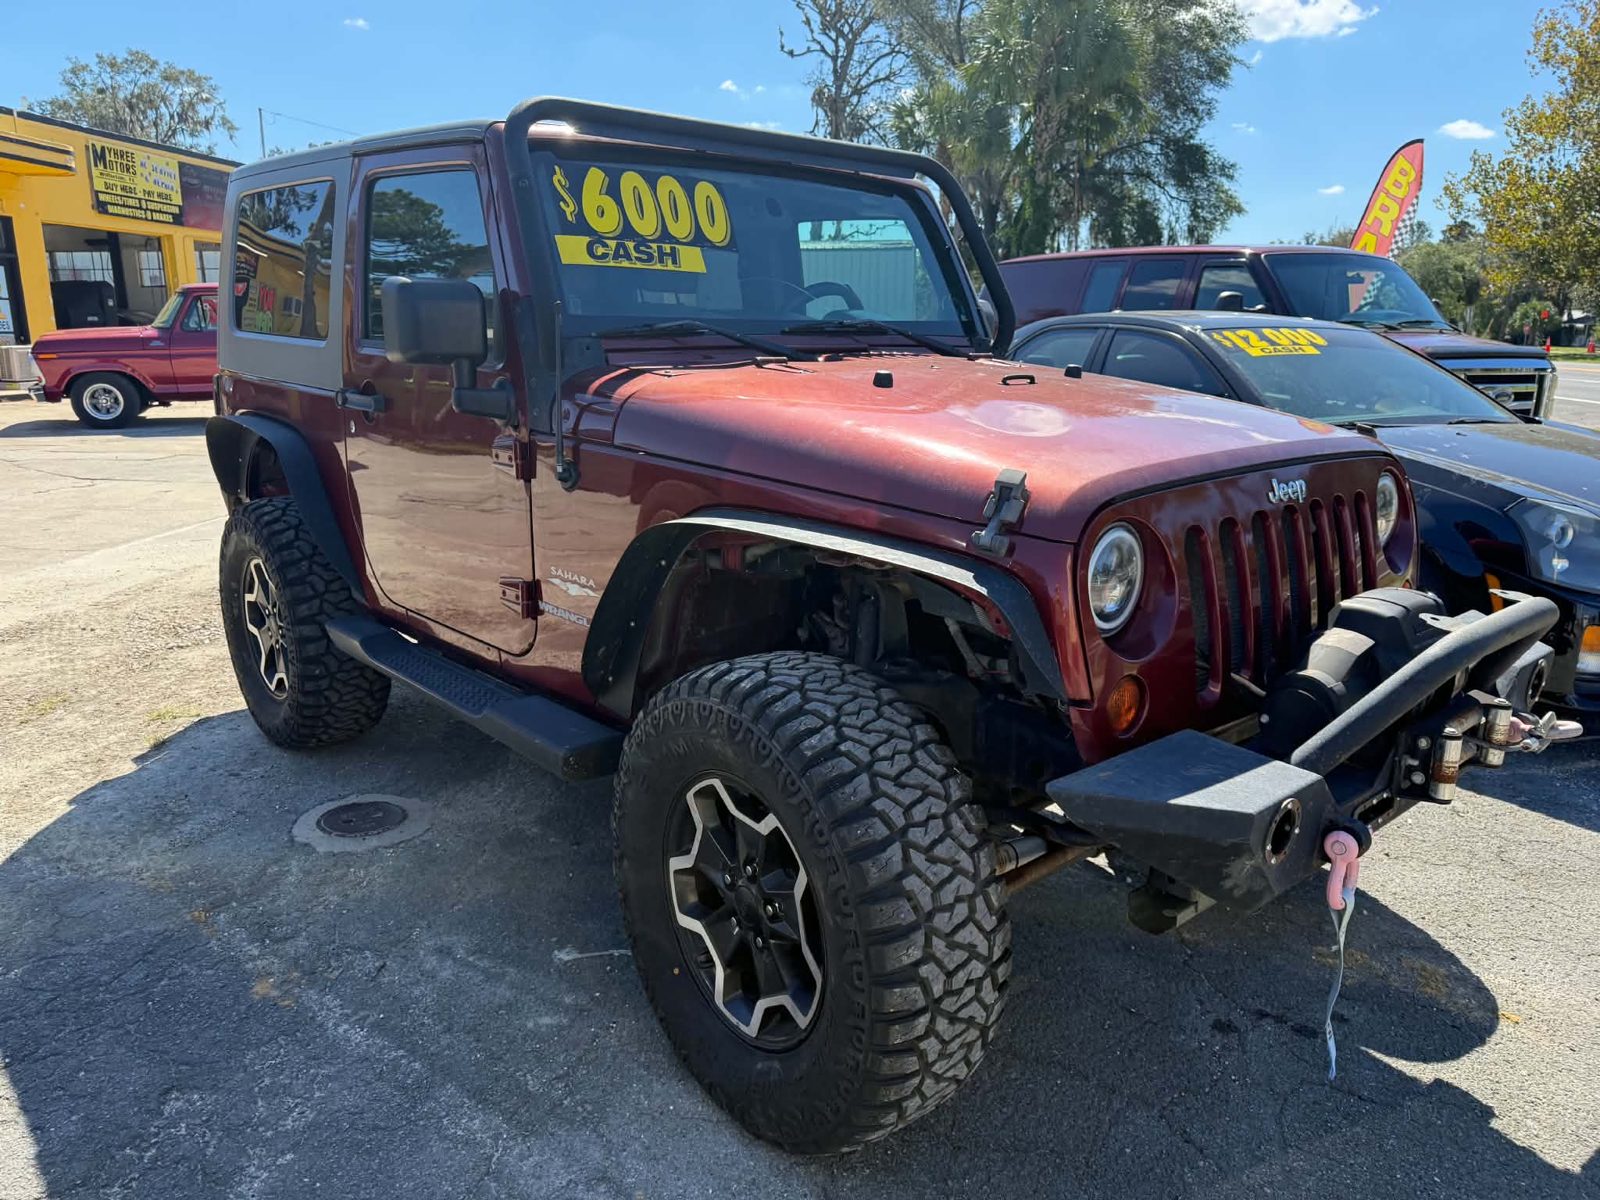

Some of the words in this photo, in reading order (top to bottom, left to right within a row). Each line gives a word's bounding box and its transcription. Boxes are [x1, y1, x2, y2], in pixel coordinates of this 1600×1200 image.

[103, 181, 118, 191] BUY
[119, 184, 138, 195] HERE
[142, 188, 155, 199] PAY
[156, 191, 173, 202] HERE
[552, 165, 731, 247] $6000
[586, 239, 681, 267] CASH
[1268, 478, 1306, 504] Jeep
[550, 566, 596, 588] SAHARA
[538, 599, 593, 628] WRANGL
